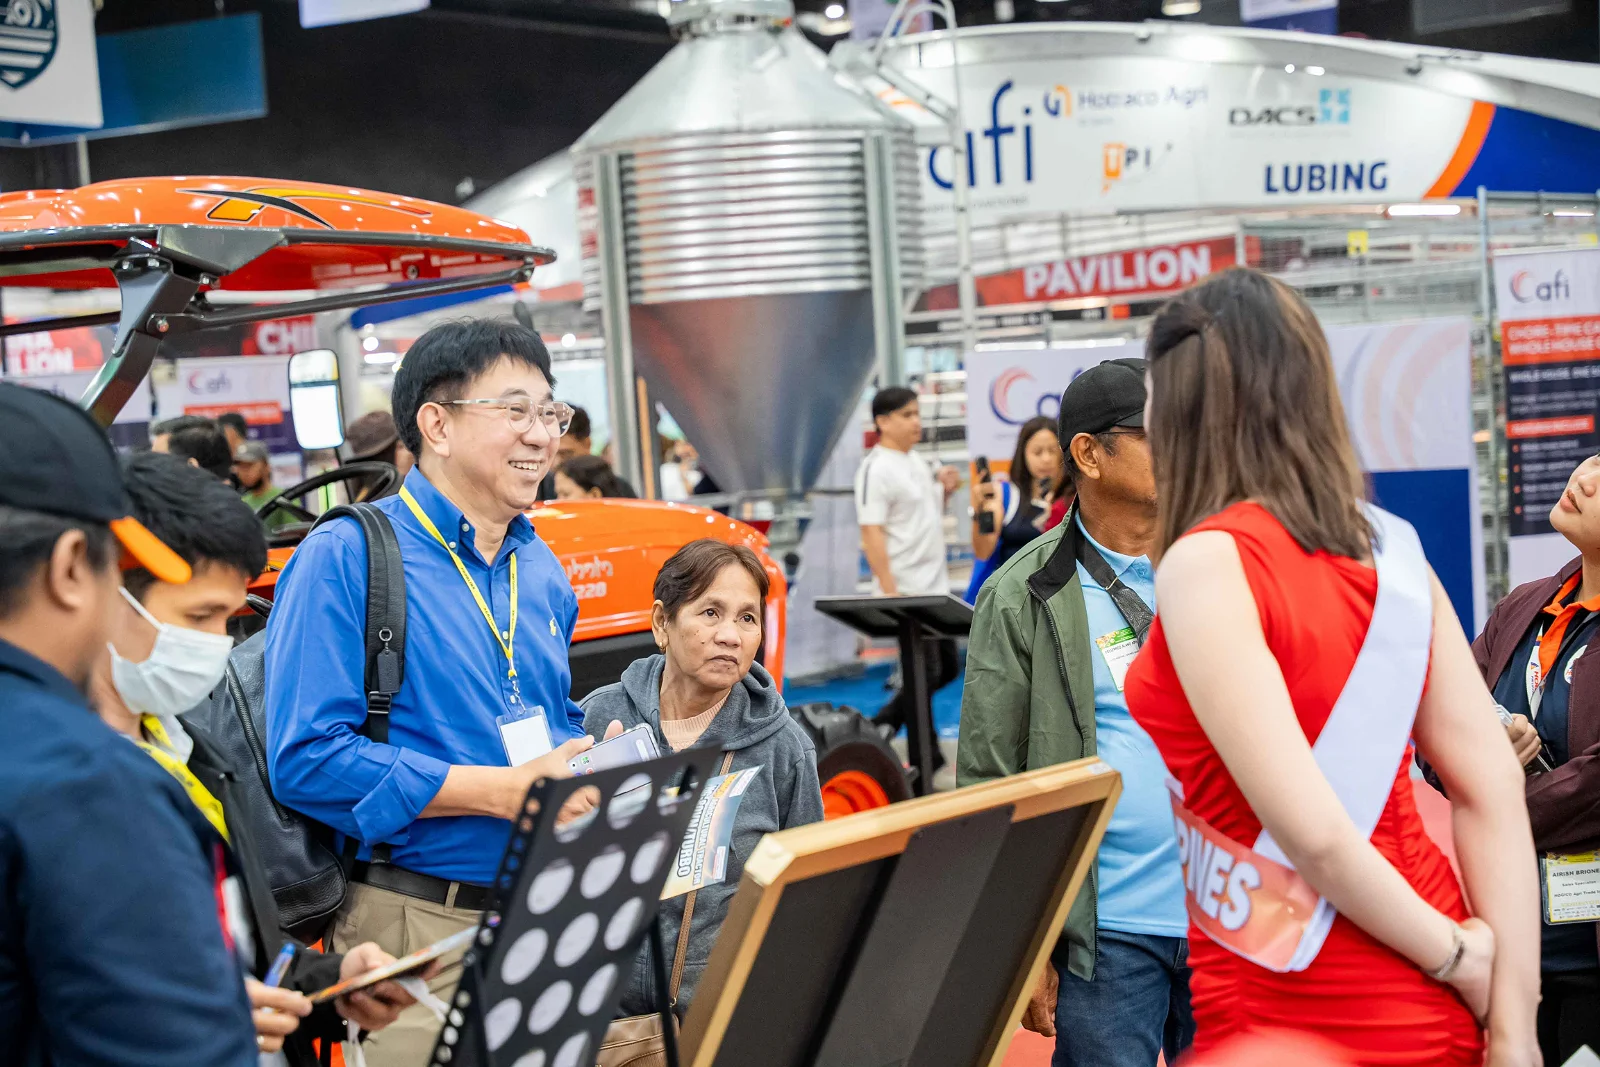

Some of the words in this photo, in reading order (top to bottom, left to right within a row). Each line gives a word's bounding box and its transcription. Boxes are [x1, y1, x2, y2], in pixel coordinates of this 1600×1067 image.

[1229, 106, 1316, 126] DACS
[1264, 162, 1388, 194] LUBING
[1024, 245, 1211, 299] PAVILION
[692, 849, 705, 886] TRACTOR
[1175, 816, 1261, 931] PINES
